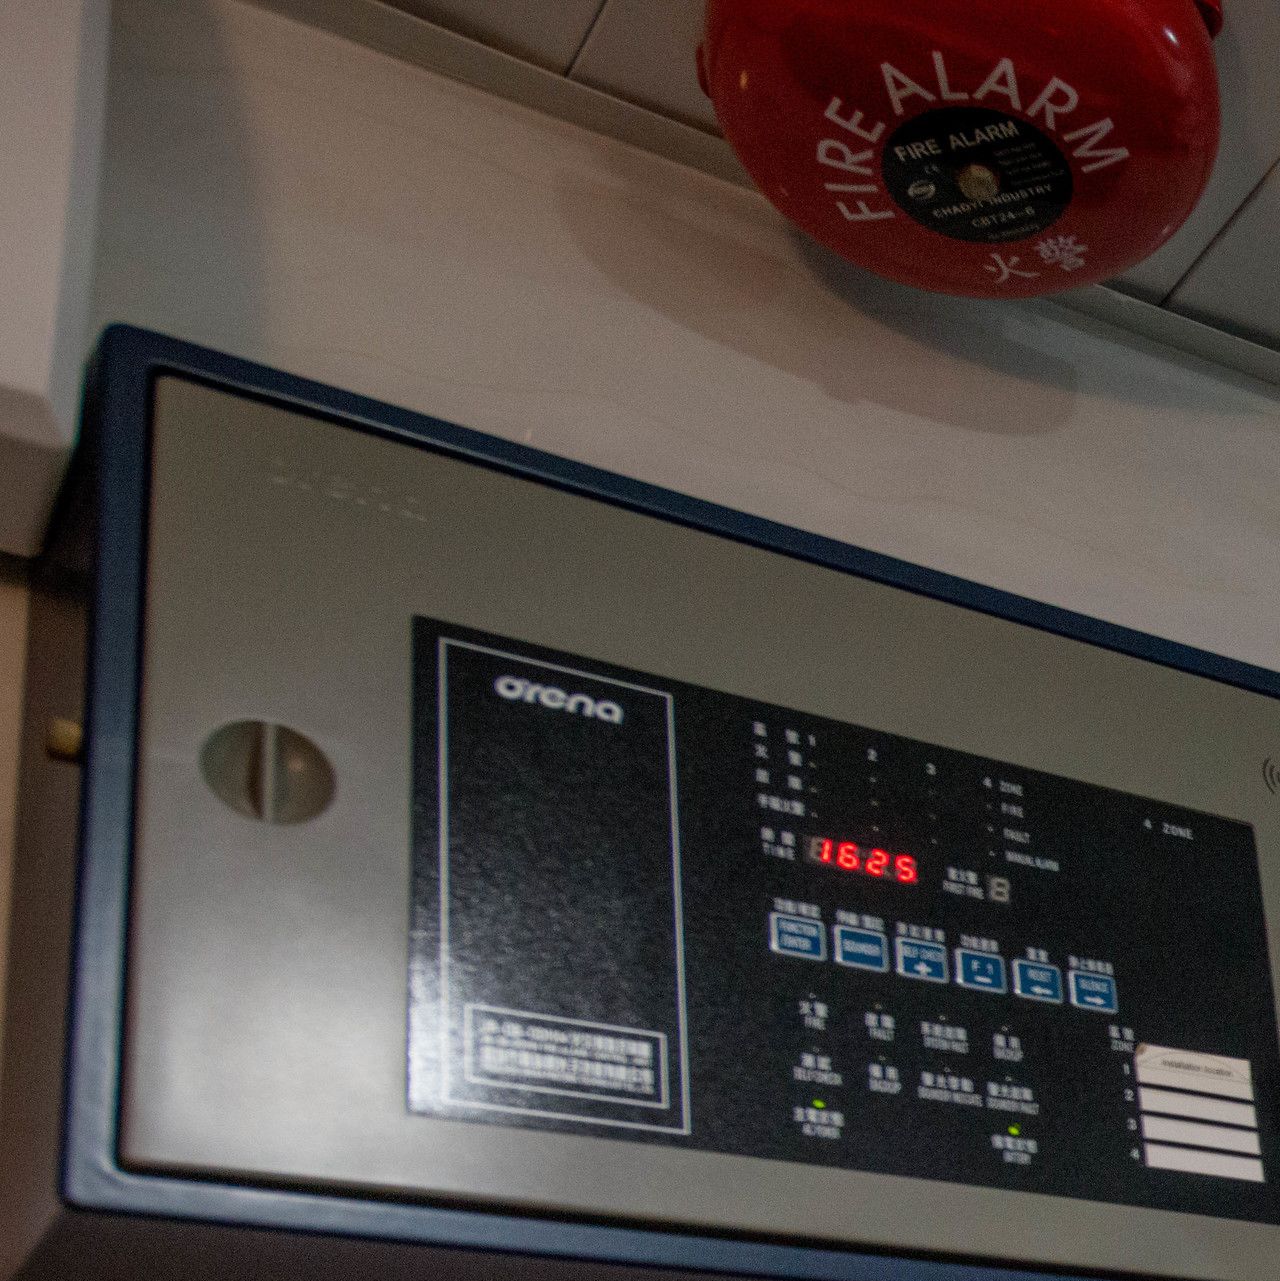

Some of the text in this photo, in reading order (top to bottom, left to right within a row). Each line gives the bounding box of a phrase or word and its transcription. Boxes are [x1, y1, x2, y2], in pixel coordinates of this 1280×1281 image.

[817, 51, 1131, 222] FIRE ALARM
[893, 120, 1021, 162] FIRE ALARM
[984, 234, 1090, 284] 火警
[494, 674, 624, 724] arena
[1161, 821, 1194, 841] ZONE
[817, 838, 919, 884] 1625
